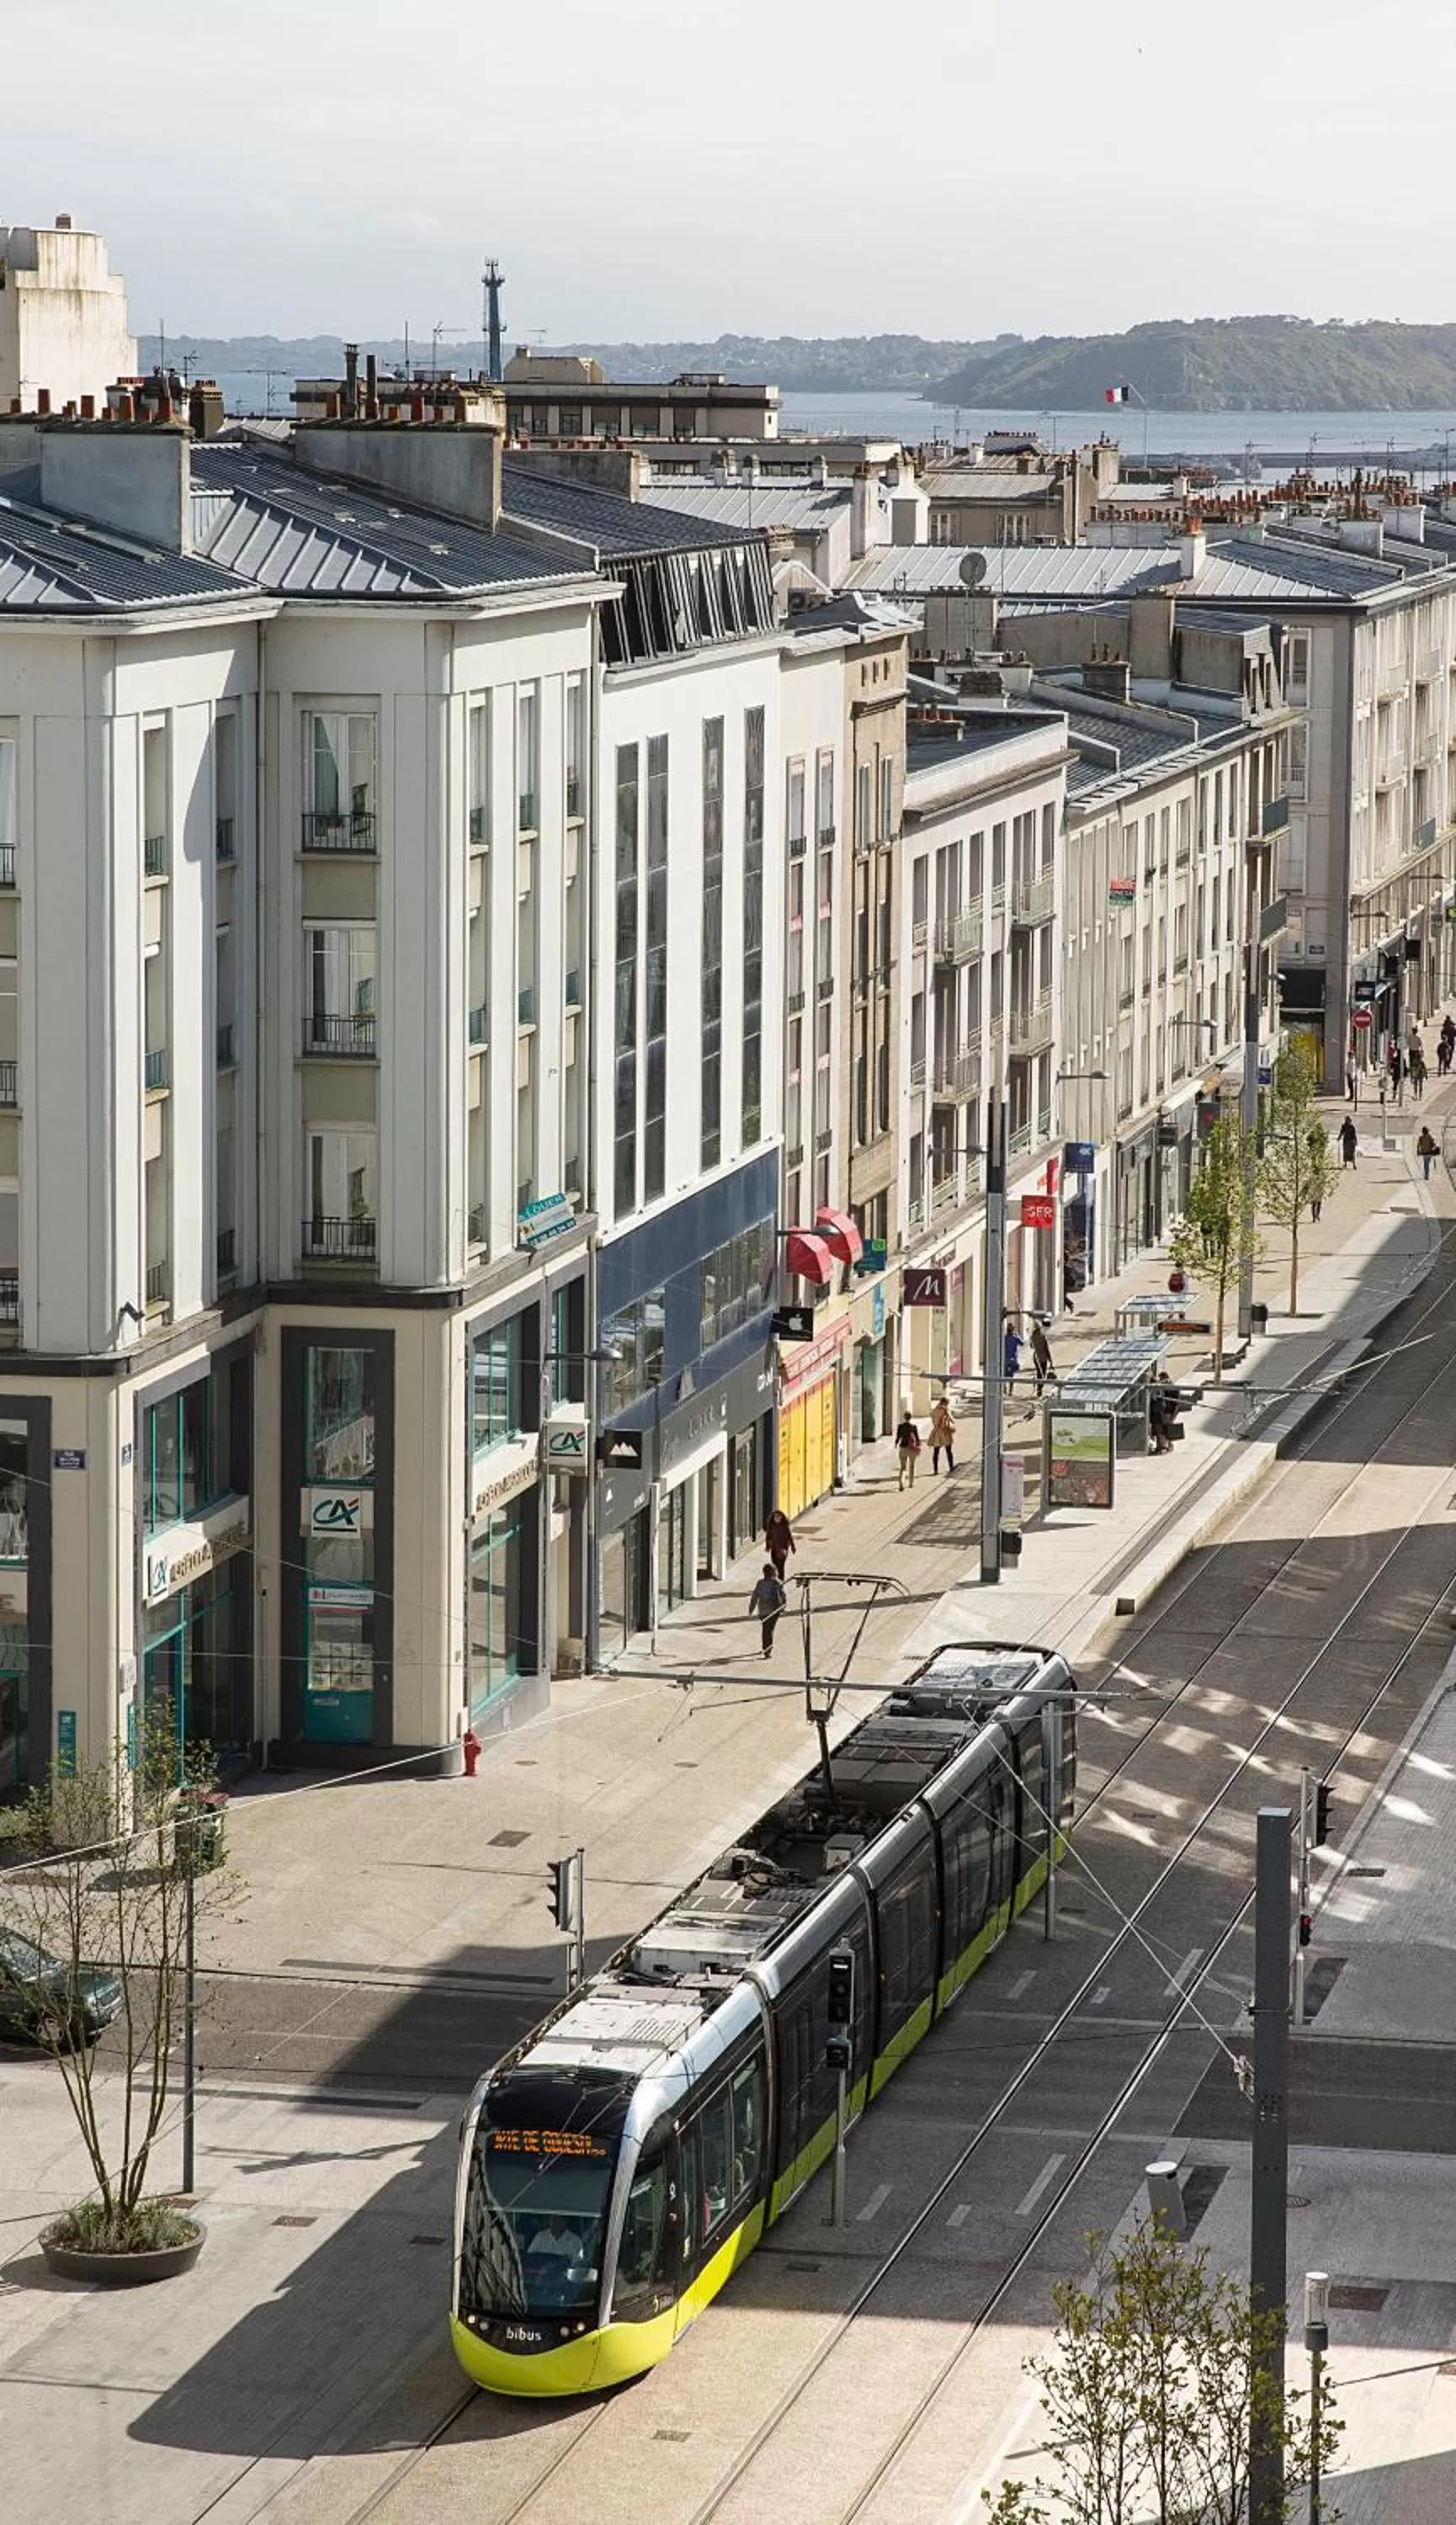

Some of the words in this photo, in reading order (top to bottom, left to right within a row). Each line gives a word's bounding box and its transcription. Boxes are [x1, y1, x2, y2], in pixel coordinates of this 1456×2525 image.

[1027, 1205, 1053, 1219] SFR
[550, 1429, 586, 1452] CA
[312, 1498, 359, 1525] CA
[506, 2326, 542, 2342] bibus
